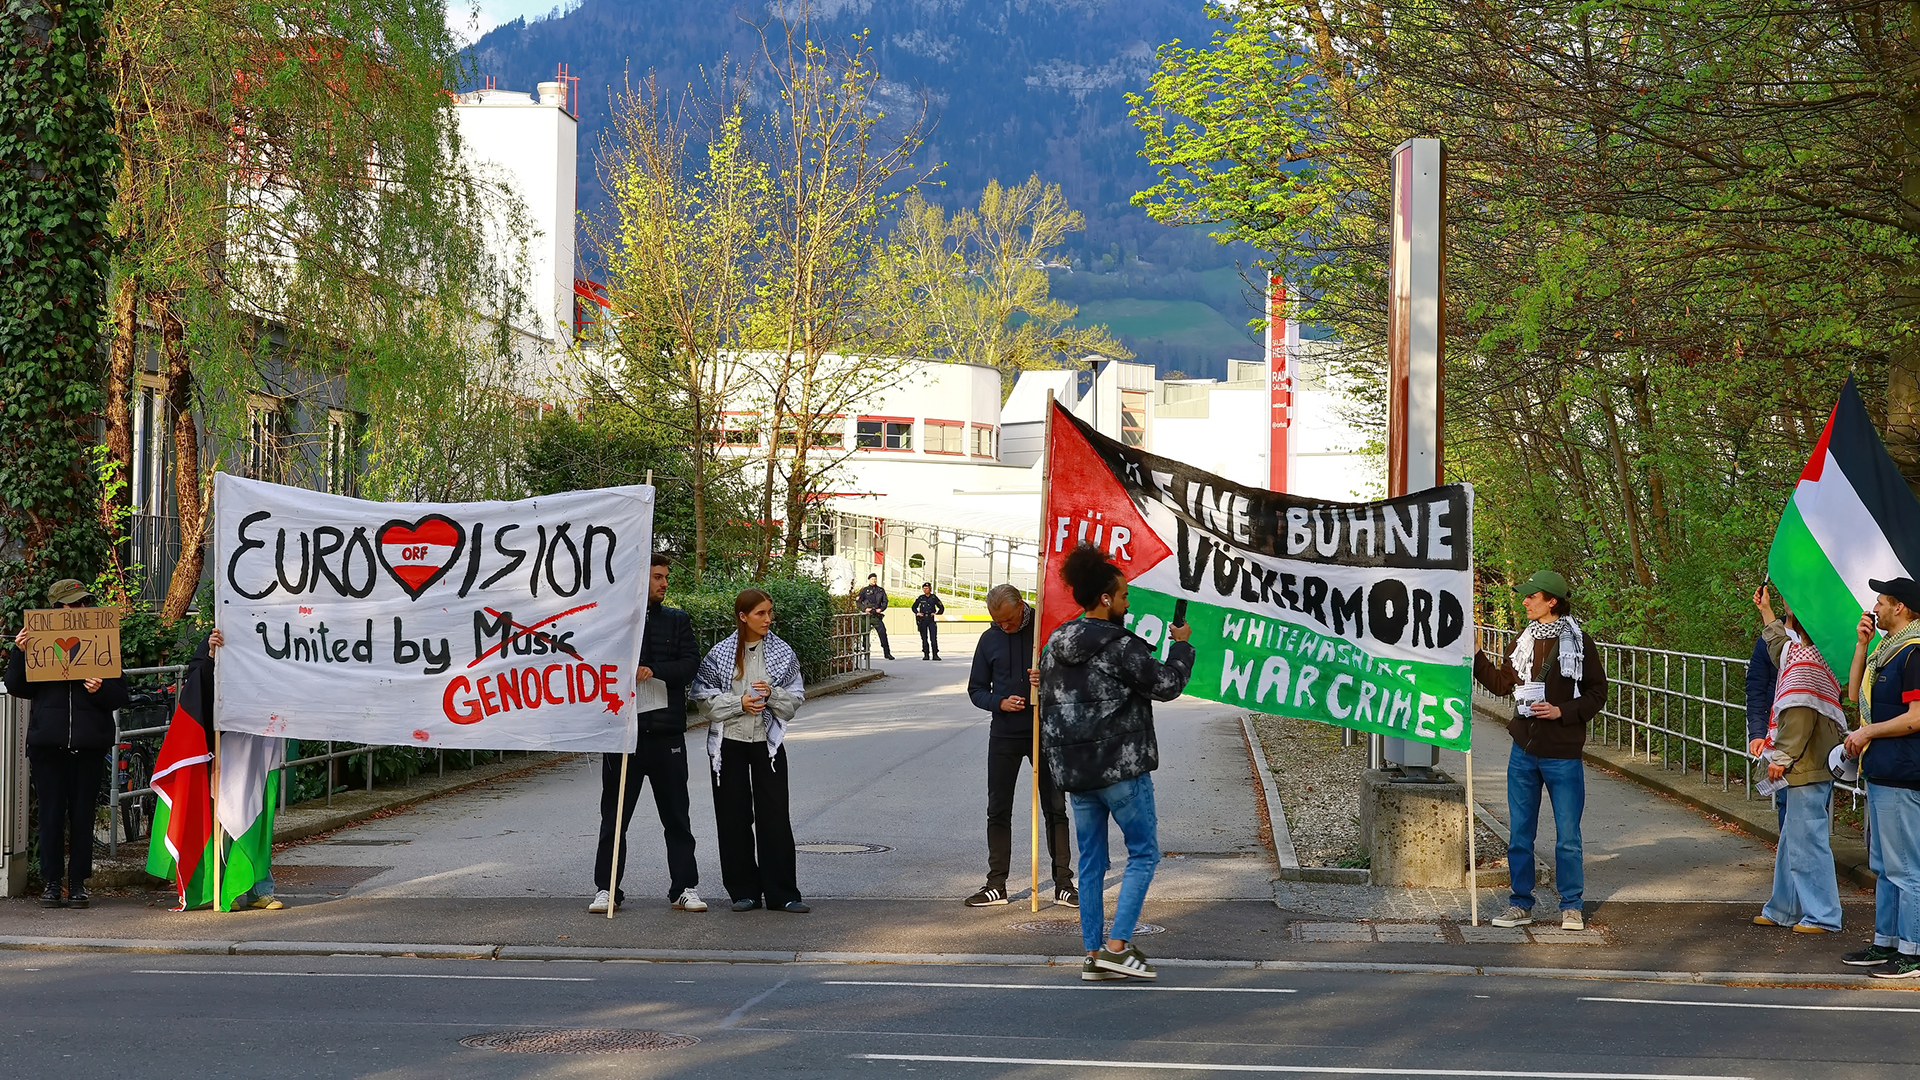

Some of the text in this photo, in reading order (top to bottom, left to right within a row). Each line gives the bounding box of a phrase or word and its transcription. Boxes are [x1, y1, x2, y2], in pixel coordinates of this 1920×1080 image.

[402, 545, 429, 561] ORF
[1055, 509, 1132, 560] FÜR
[1286, 499, 1453, 560] BÜHNE
[1175, 515, 1465, 650] VÖLKERMORD
[27, 609, 115, 631] KEINE BÜHNE FÜR
[256, 618, 373, 664] United
[393, 616, 452, 674] by
[1222, 612, 1417, 686] WHITEWASHING
[443, 664, 620, 724] GENOCIDE
[1219, 648, 1317, 707] WAR
[1326, 672, 1466, 740] CRIMES
